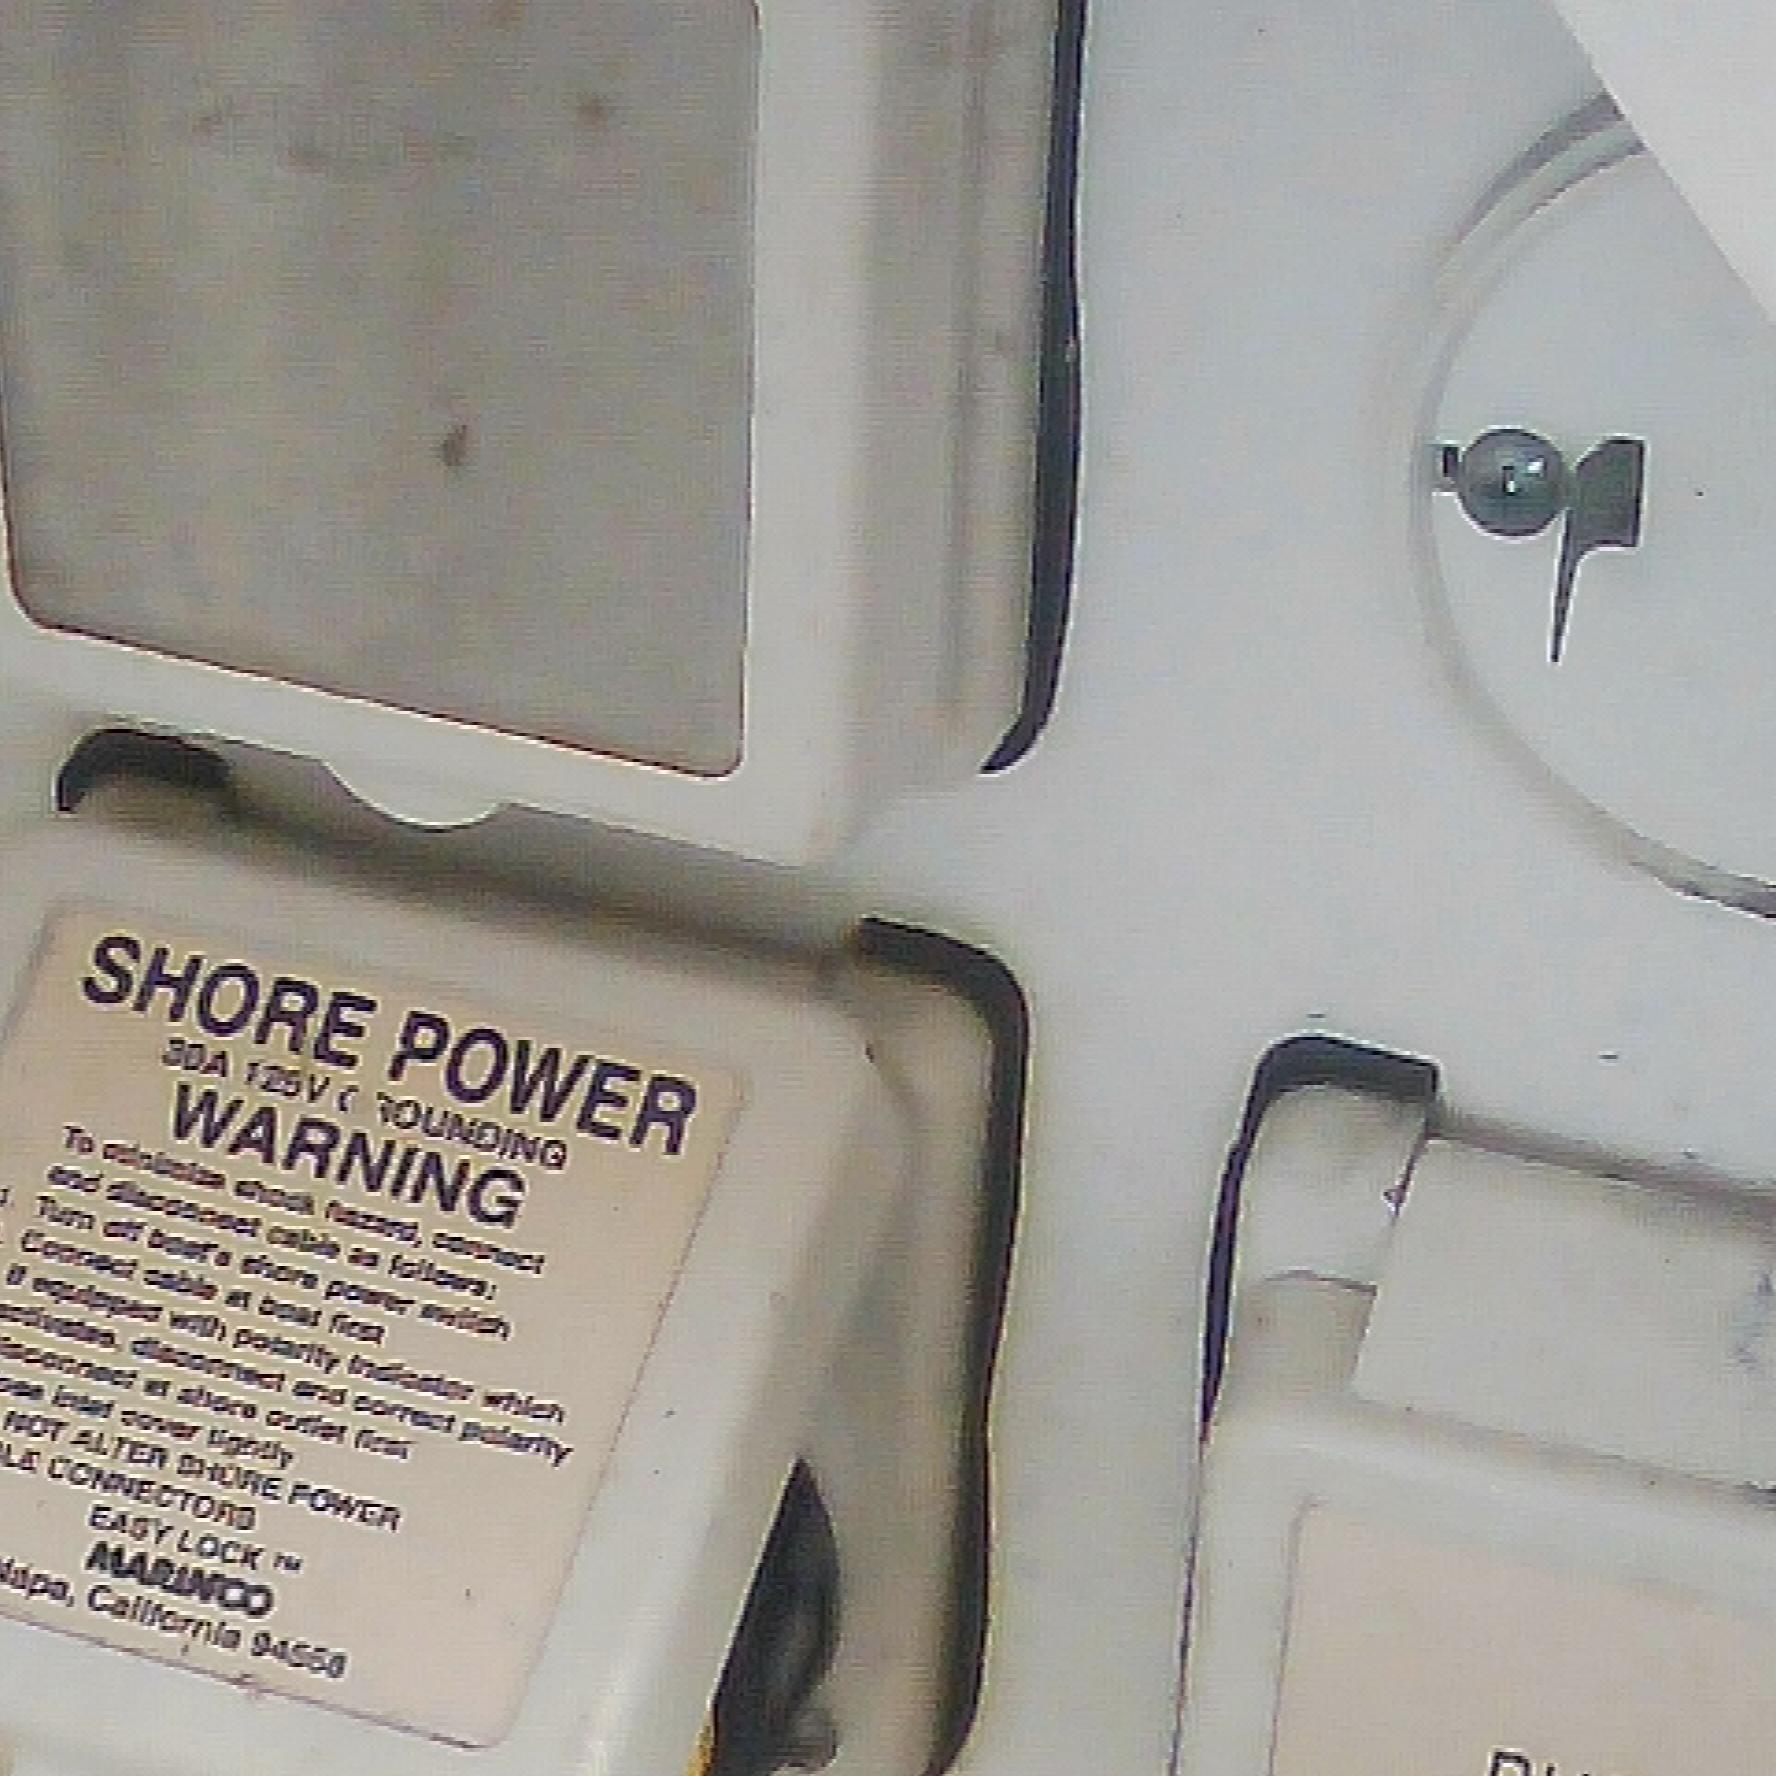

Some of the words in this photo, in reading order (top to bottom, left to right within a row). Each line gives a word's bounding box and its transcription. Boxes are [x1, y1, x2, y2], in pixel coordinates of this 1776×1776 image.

[80, 935, 377, 1070] SHORE
[388, 1009, 698, 1157] POWER
[63, 1126, 94, 1152] To
[172, 1083, 527, 1229] WARNING
[22, 1230, 137, 1279] Connect
[144, 1269, 218, 1300] cable
[36, 1196, 95, 1229] Turn
[103, 1220, 147, 1241] off
[240, 1255, 319, 1289] shore
[325, 1280, 416, 1315] power
[267, 1226, 340, 1258] cable
[170, 1311, 226, 1341] with
[233, 1328, 340, 1375] polarity
[131, 1337, 286, 1393] disconnect
[353, 1395, 456, 1434] correct
[460, 1421, 574, 1468] polarity
[3, 1410, 70, 1441] NOT
[70, 1430, 168, 1470] ALTER
[176, 1453, 283, 1501] SHORE
[288, 1483, 402, 1532] POWER
[47, 1456, 257, 1530] CONNECTORS
[88, 1503, 173, 1544] EASY
[177, 1528, 265, 1570] LOCK
[84, 1539, 274, 1619] MARINCO
[87, 1584, 241, 1651] California
